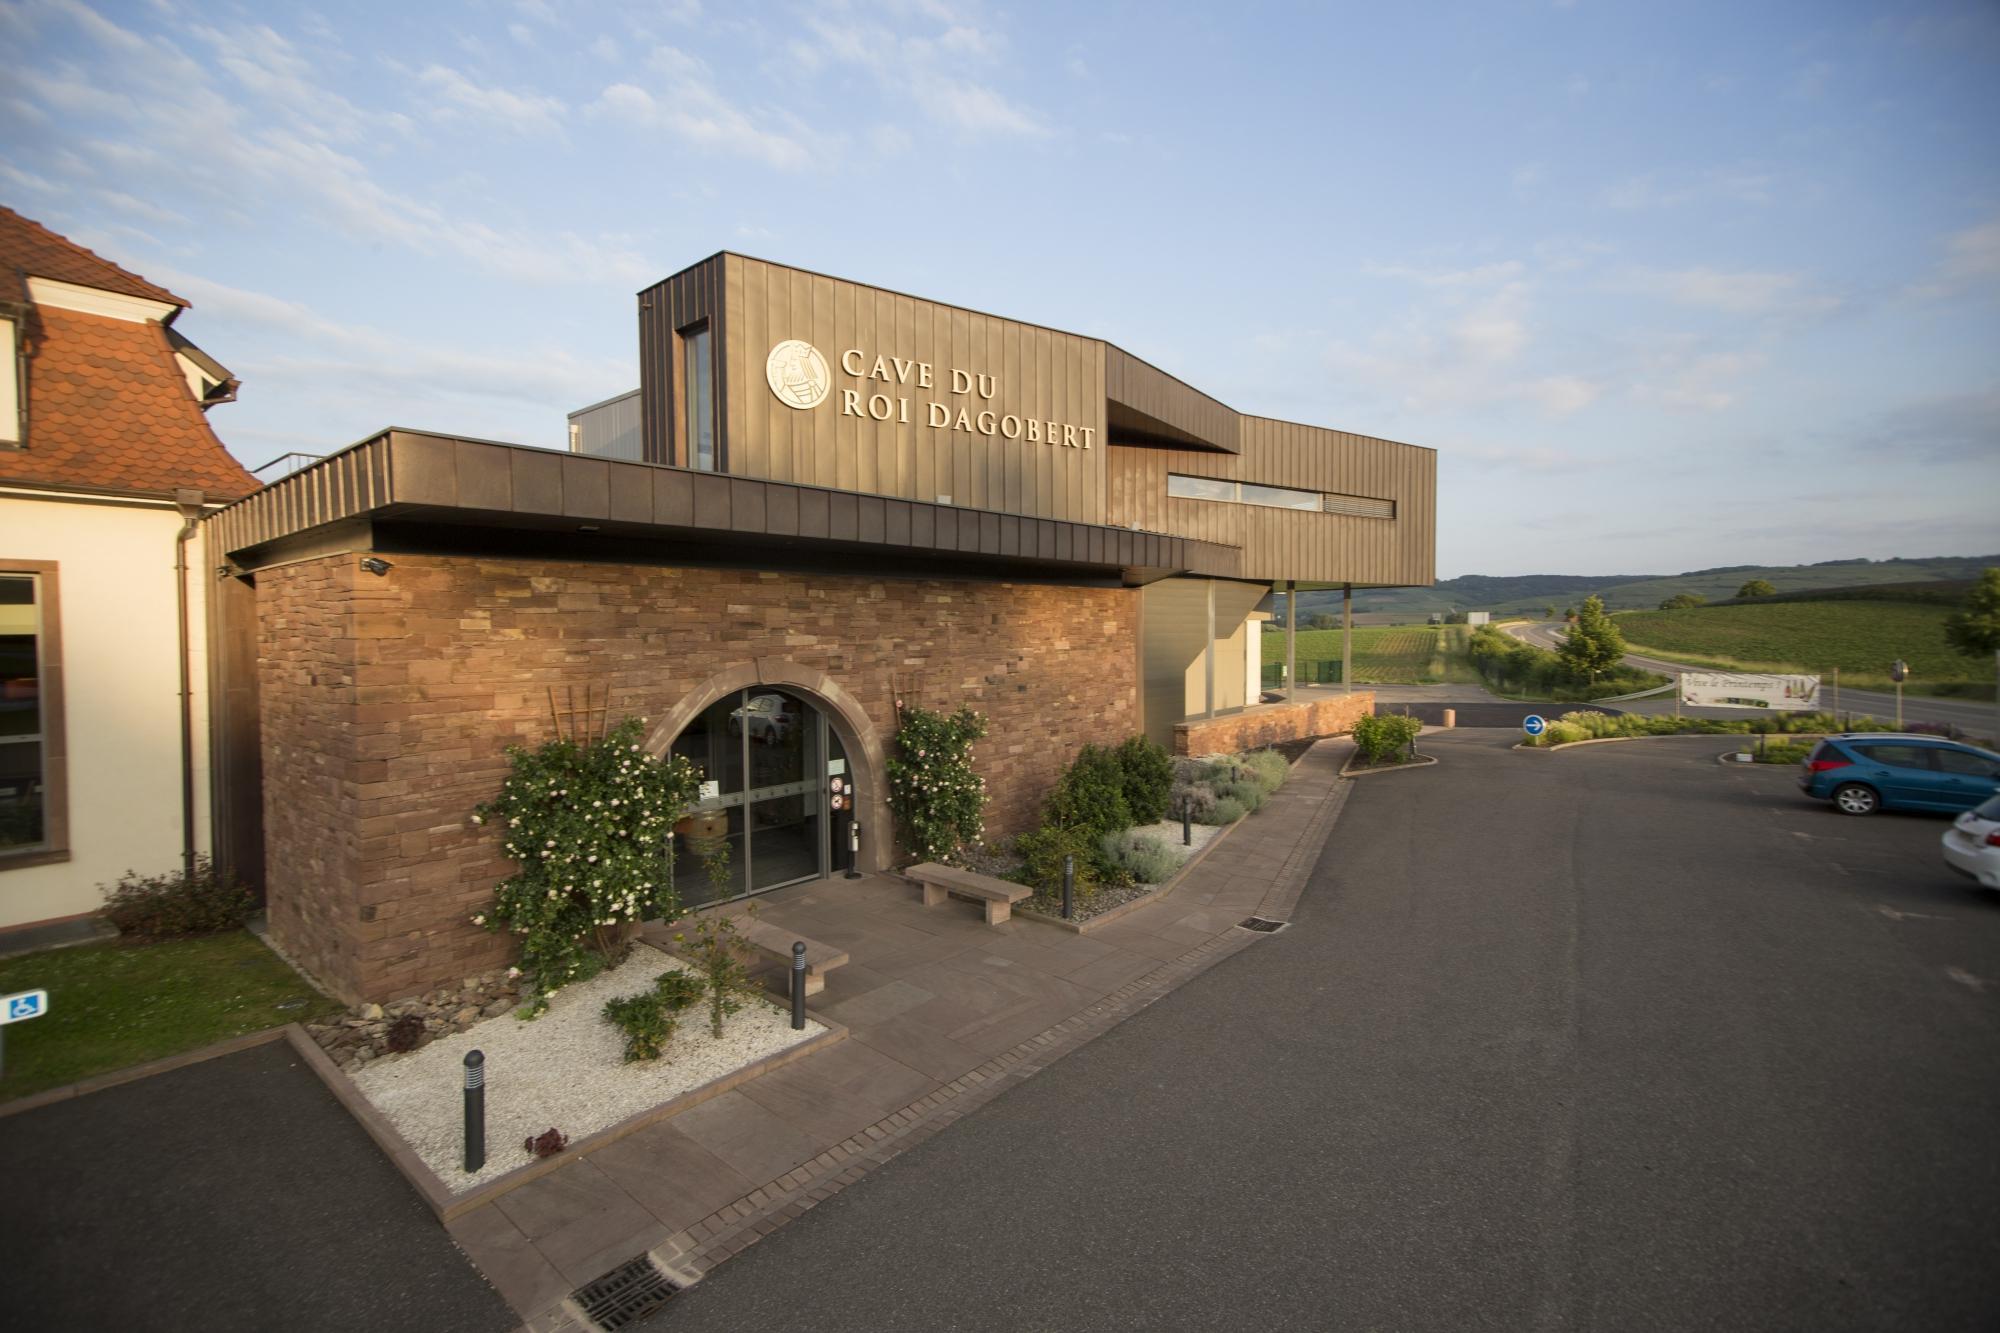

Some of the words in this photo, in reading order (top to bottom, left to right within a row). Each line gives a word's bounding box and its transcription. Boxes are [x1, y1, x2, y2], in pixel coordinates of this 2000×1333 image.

[842, 349, 933, 388] CAVE
[950, 368, 997, 399] DU
[842, 389, 911, 423] ROI
[928, 402, 1096, 449] DAGOBERT
